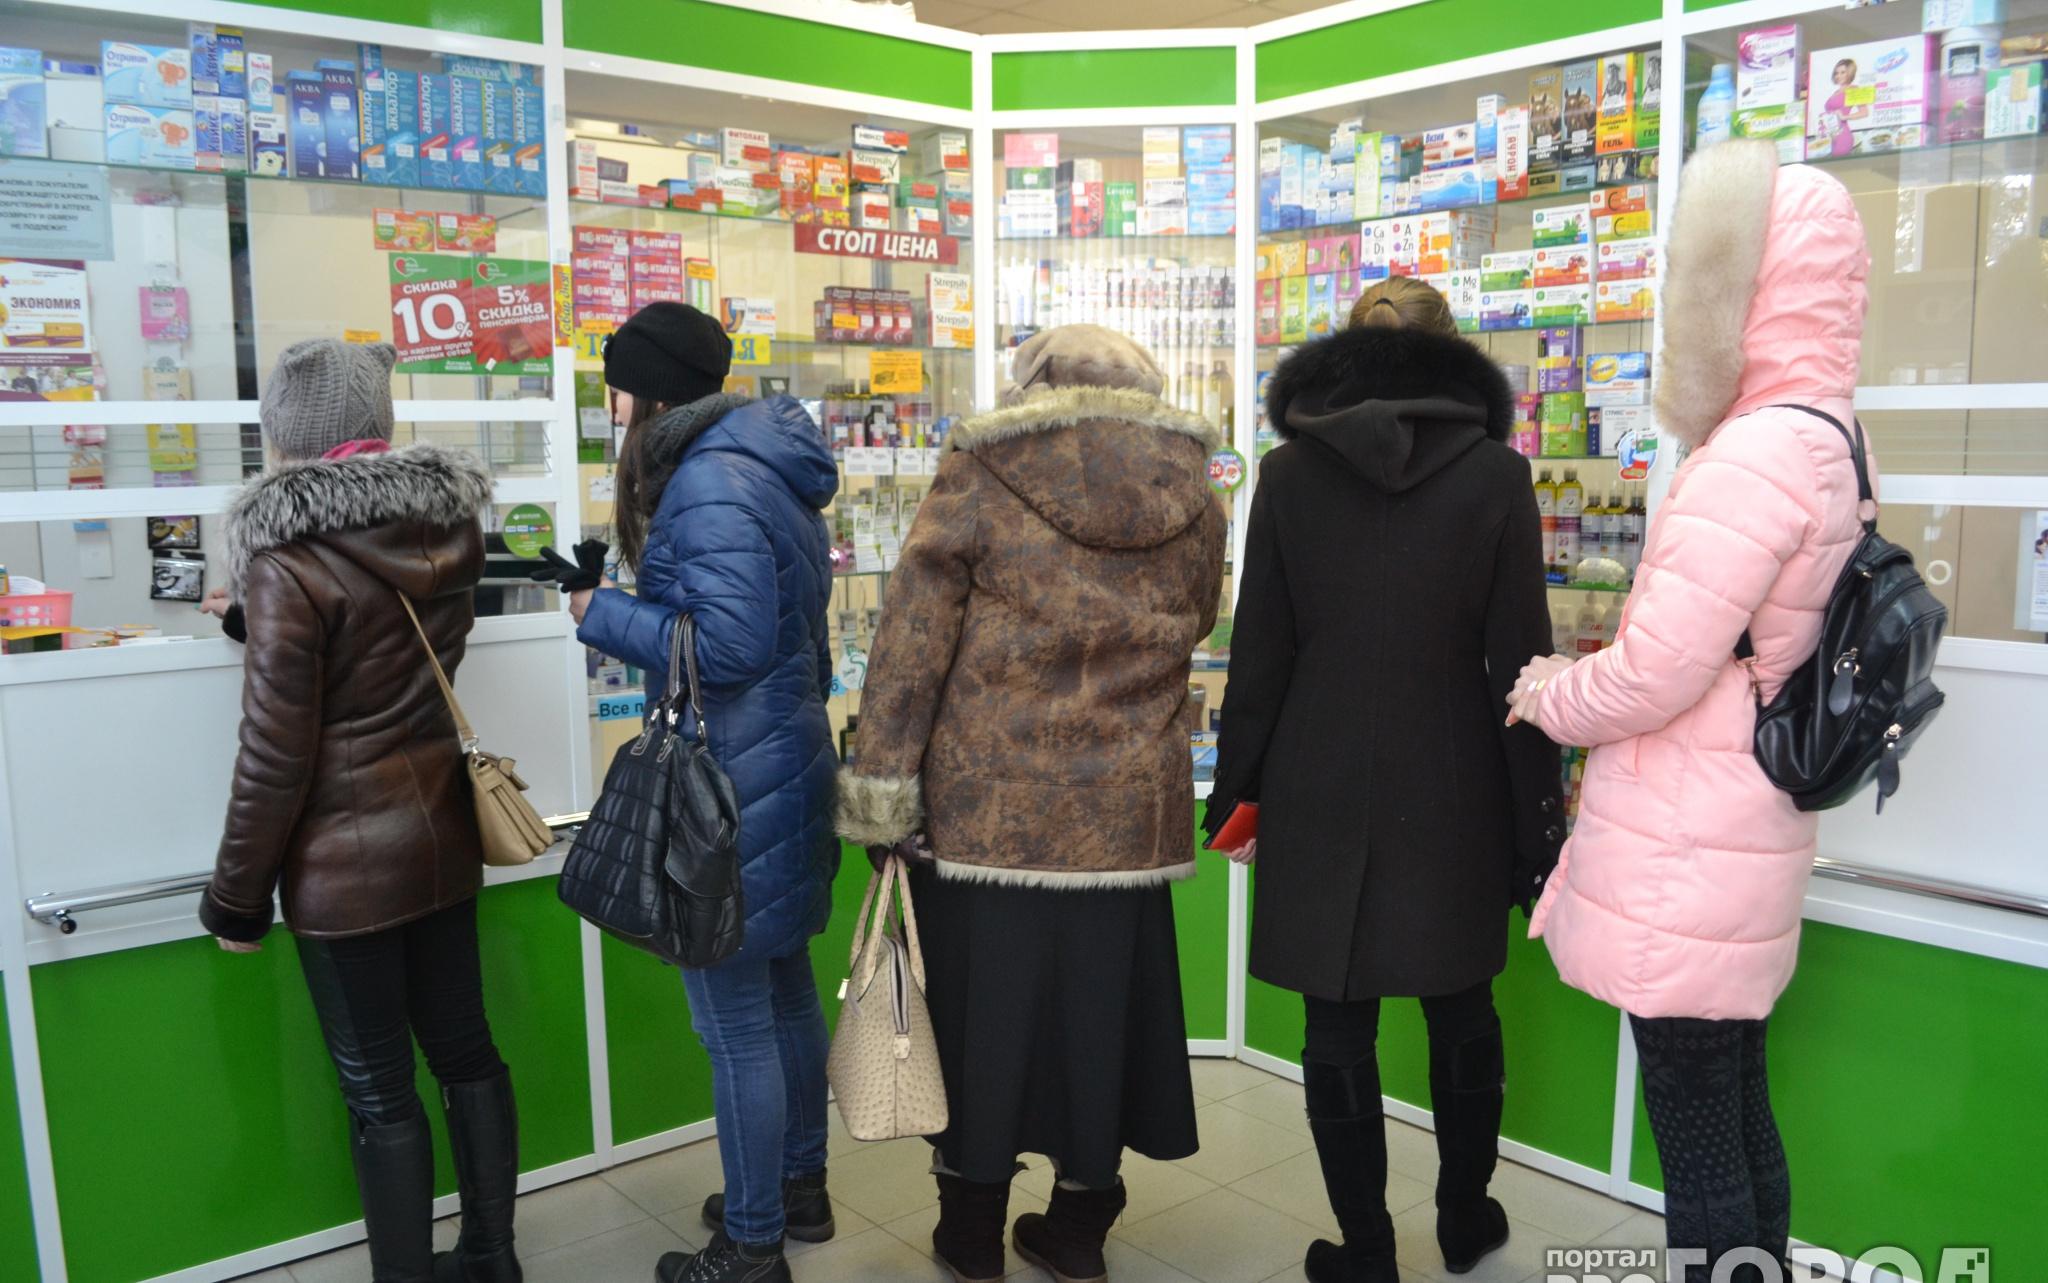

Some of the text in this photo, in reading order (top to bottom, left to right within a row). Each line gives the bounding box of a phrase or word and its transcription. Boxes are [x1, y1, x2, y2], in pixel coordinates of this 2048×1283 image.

[324, 73, 353, 85] АКВА
[294, 83, 321, 95] АКВА
[387, 71, 398, 131] аквалор
[421, 74, 432, 134] аквалор
[452, 78, 463, 136] аквалор
[363, 91, 373, 145] аквалор
[485, 81, 496, 140] аквалор
[515, 86, 525, 143] аквалор
[1373, 227, 1385, 239] Ca
[1404, 225, 1412, 236] A
[817, 228, 938, 260] СТОП ЦЕНА
[1402, 241, 1414, 251] Zn
[402, 279, 457, 295] скидка
[1462, 276, 1477, 290] Mg
[10, 296, 81, 310] ЭКОНОМИЯ
[497, 284, 529, 305] 5%
[393, 293, 474, 345] 10%
[478, 302, 545, 321] скидка
[1555, 329, 1569, 337] 40+
[600, 702, 630, 717] Все
